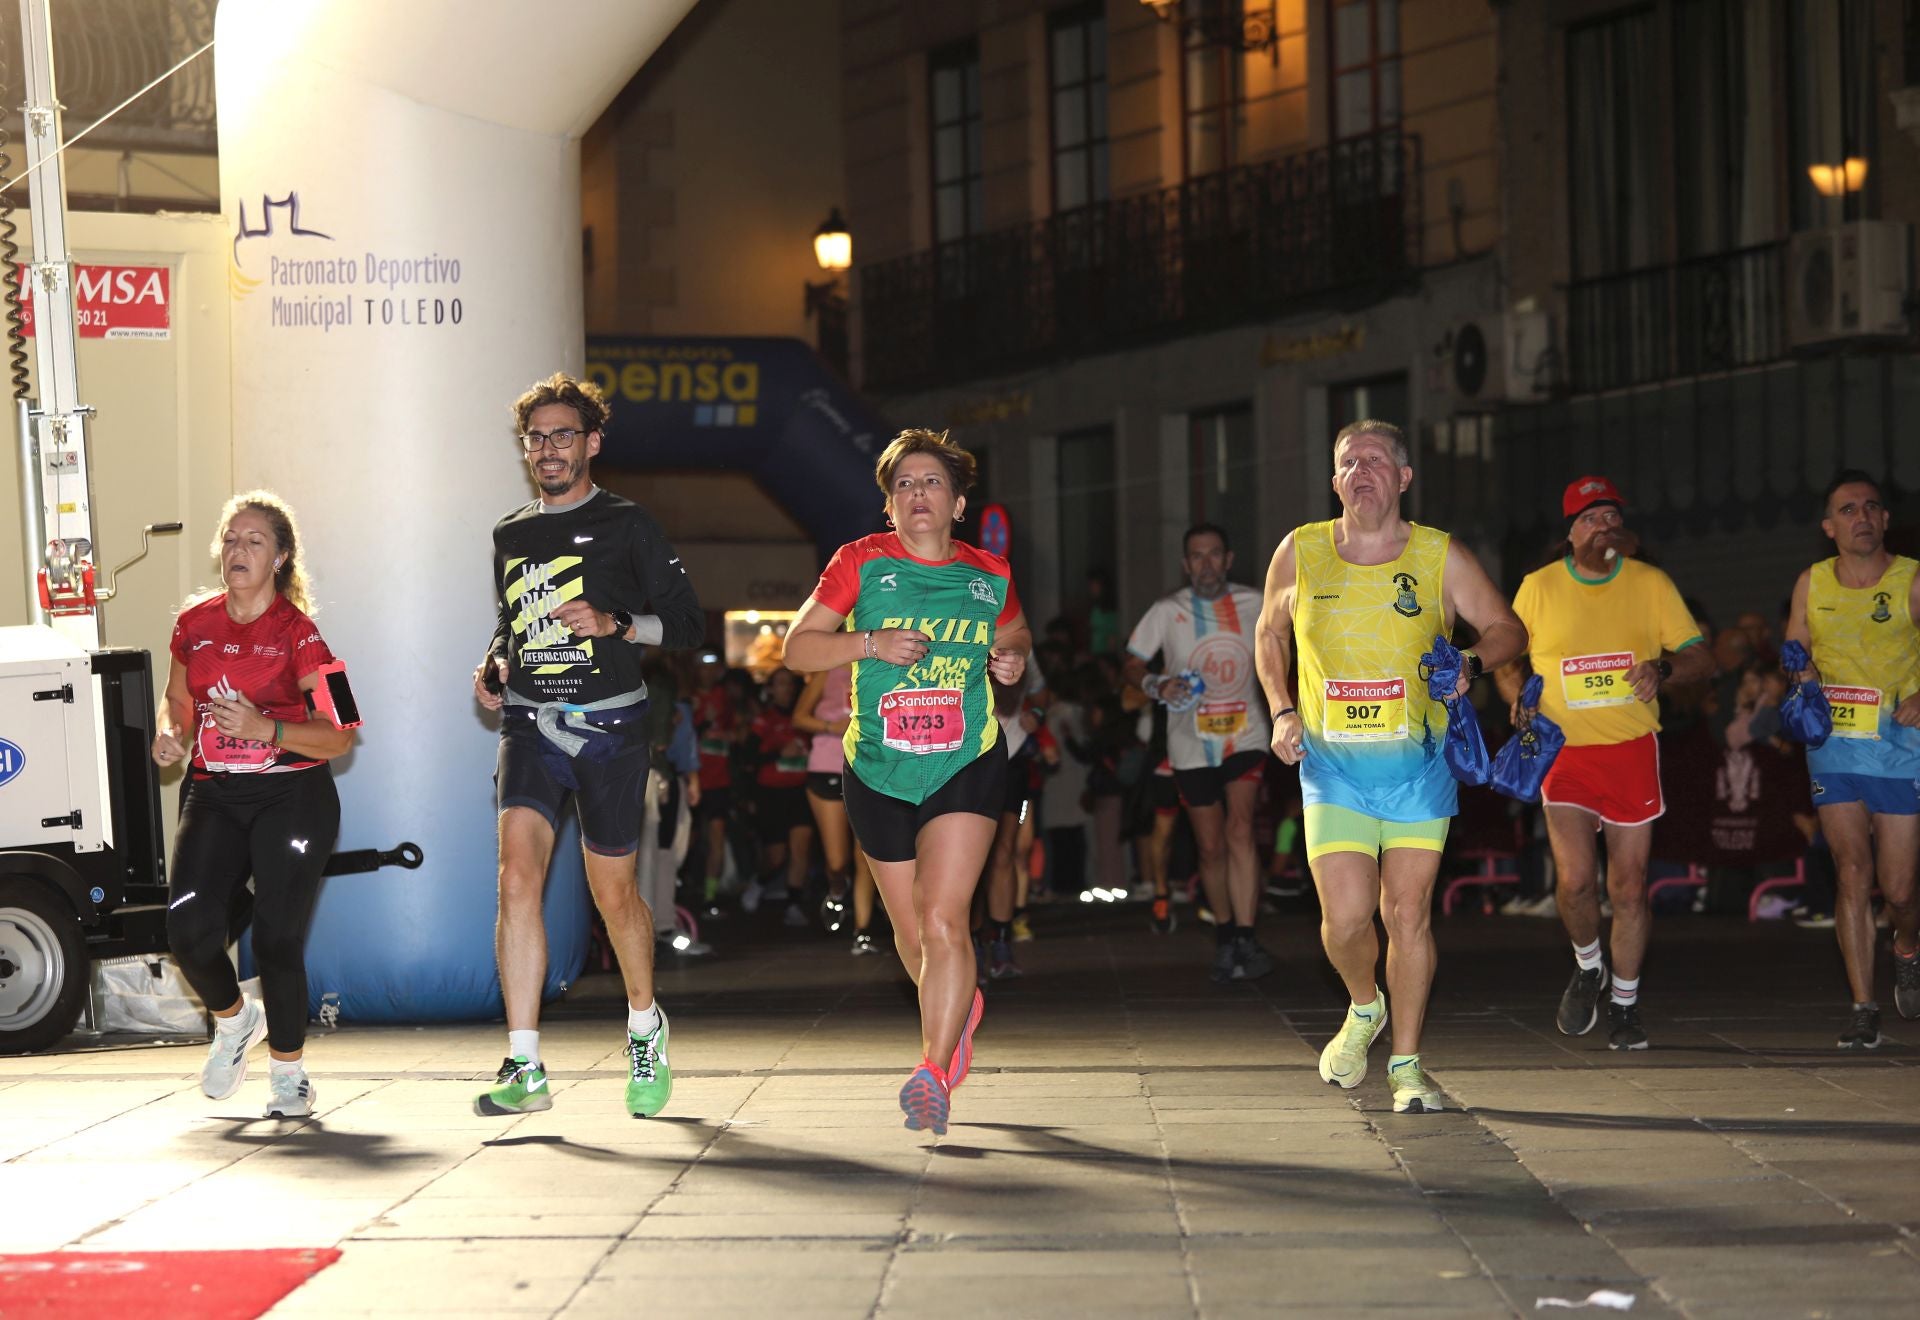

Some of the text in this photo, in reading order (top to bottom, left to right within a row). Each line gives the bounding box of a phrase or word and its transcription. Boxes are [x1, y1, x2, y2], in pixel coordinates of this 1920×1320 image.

[271, 252, 461, 290] Patronato Deportivo
[19, 267, 166, 305] MSA
[94, 310, 107, 326] 21
[272, 294, 463, 332] Municipal TOLEDO
[110, 330, 168, 338] www.remsa.net
[522, 563, 557, 591] WE
[520, 590, 562, 620] RUN
[525, 618, 570, 645] MAD
[523, 650, 588, 663] INTERNACIONAL
[1577, 657, 1631, 671] Santander
[548, 678, 583, 686] SILVESTRE
[1584, 674, 1615, 689] 536
[897, 694, 959, 708] Santander
[1828, 689, 1878, 702] Santander
[1346, 705, 1382, 720] 907
[898, 714, 945, 731] 3733
